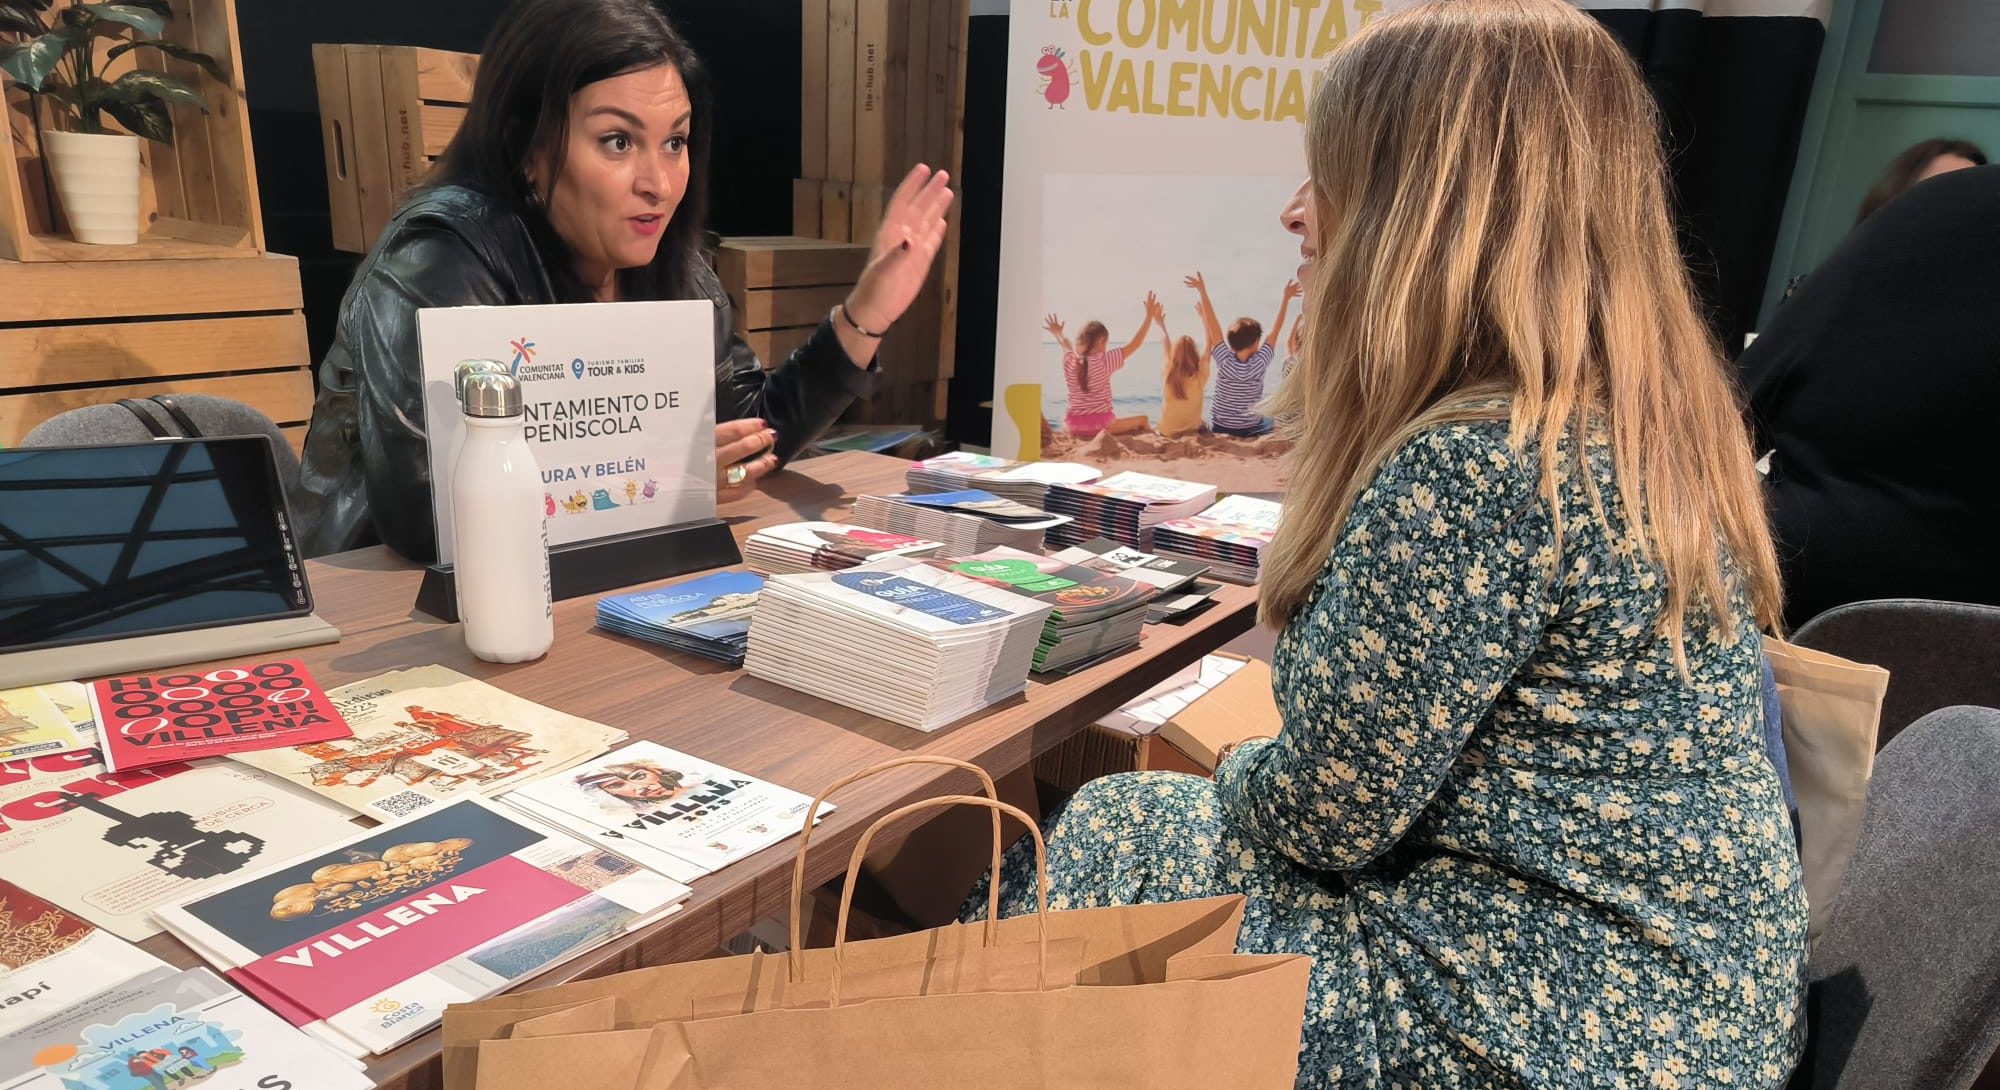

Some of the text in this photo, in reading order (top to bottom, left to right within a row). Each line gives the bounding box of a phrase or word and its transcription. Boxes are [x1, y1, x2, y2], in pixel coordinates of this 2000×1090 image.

[1050, 2, 1069, 18] LA
[1079, 50, 1322, 123] VALENCIA
[518, 372, 566, 382] VALENCIANA
[519, 363, 564, 374] COMUNITAT
[587, 363, 646, 377] TOUR & KIDS
[524, 391, 680, 422] NTAMIENTO DE
[524, 415, 642, 443] PEÑÍSCOLA
[541, 456, 647, 484] URA Y BELÉN
[123, 713, 331, 747] VILLENA
[682, 798, 732, 822] 2023
[273, 884, 488, 968] VILLENA
[0, 981, 52, 1009] apí
[380, 1005, 425, 1029] Blanca
[382, 1002, 419, 1021] Costa
[98, 1015, 186, 1050] VILLENA
